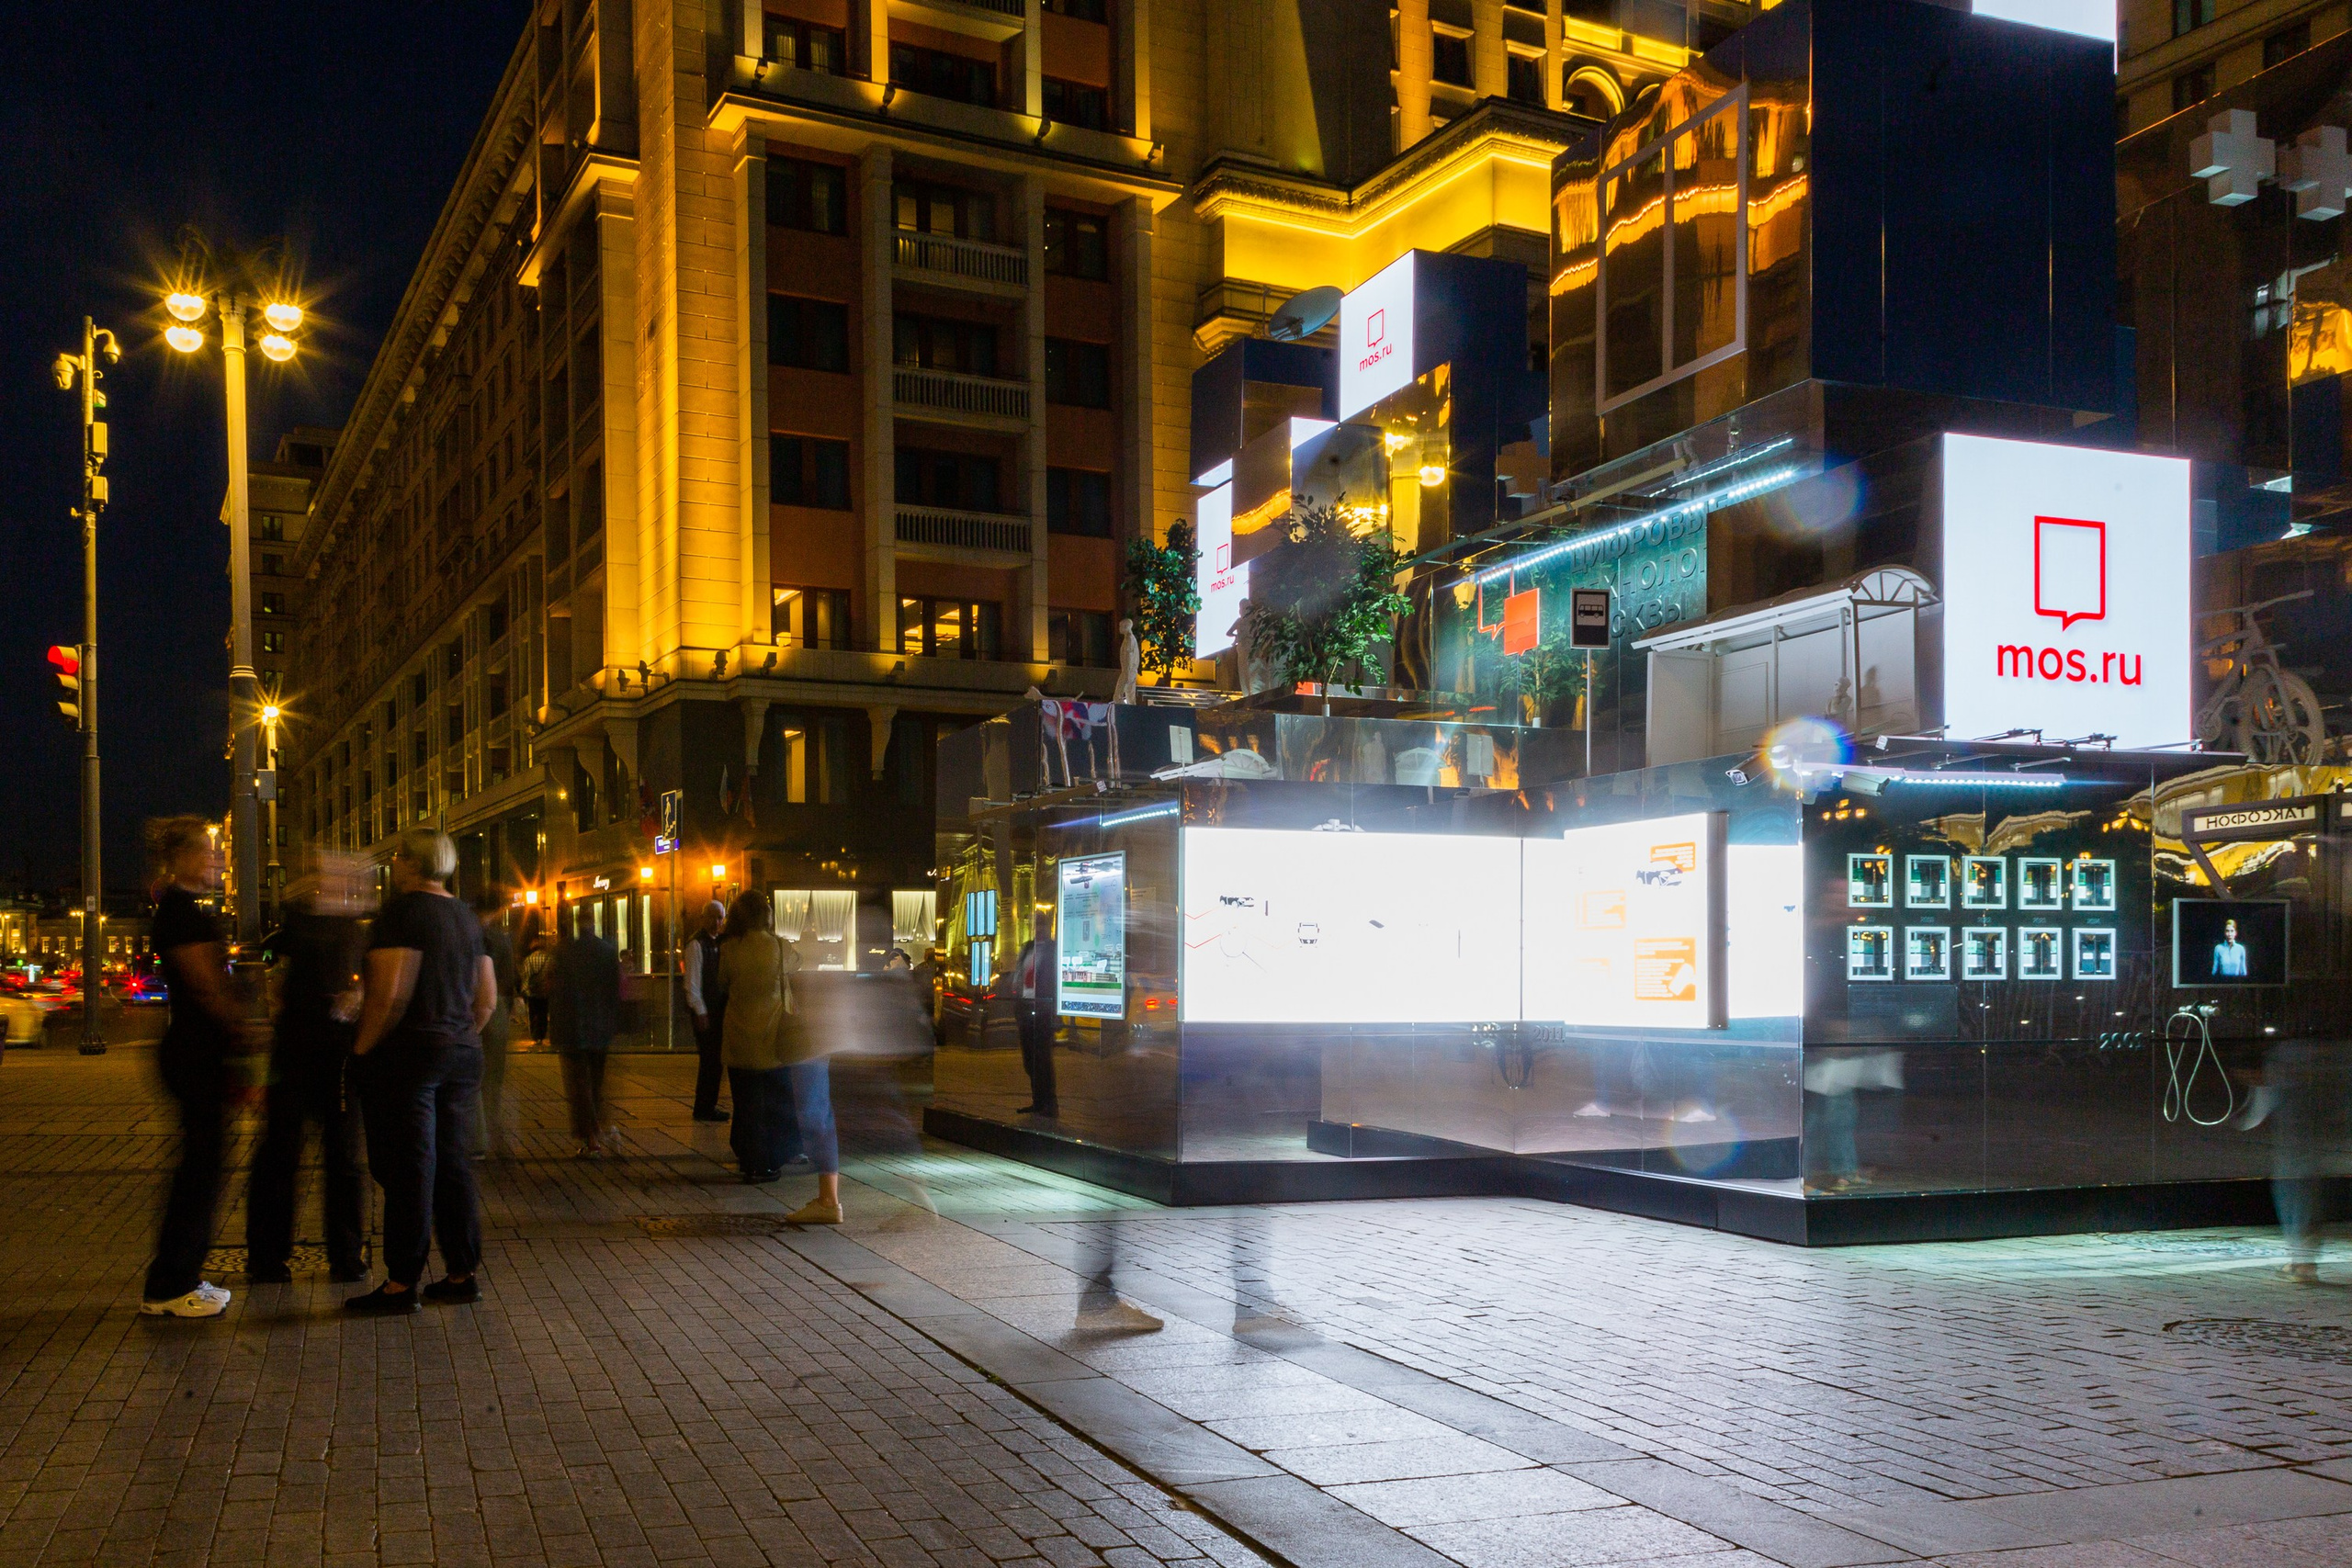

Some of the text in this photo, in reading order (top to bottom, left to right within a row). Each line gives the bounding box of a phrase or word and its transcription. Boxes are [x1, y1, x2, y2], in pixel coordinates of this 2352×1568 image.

[1359, 344, 1393, 372] mos.ru
[1210, 575, 1235, 592] mos.ru
[1996, 644, 2142, 686] mos.ru
